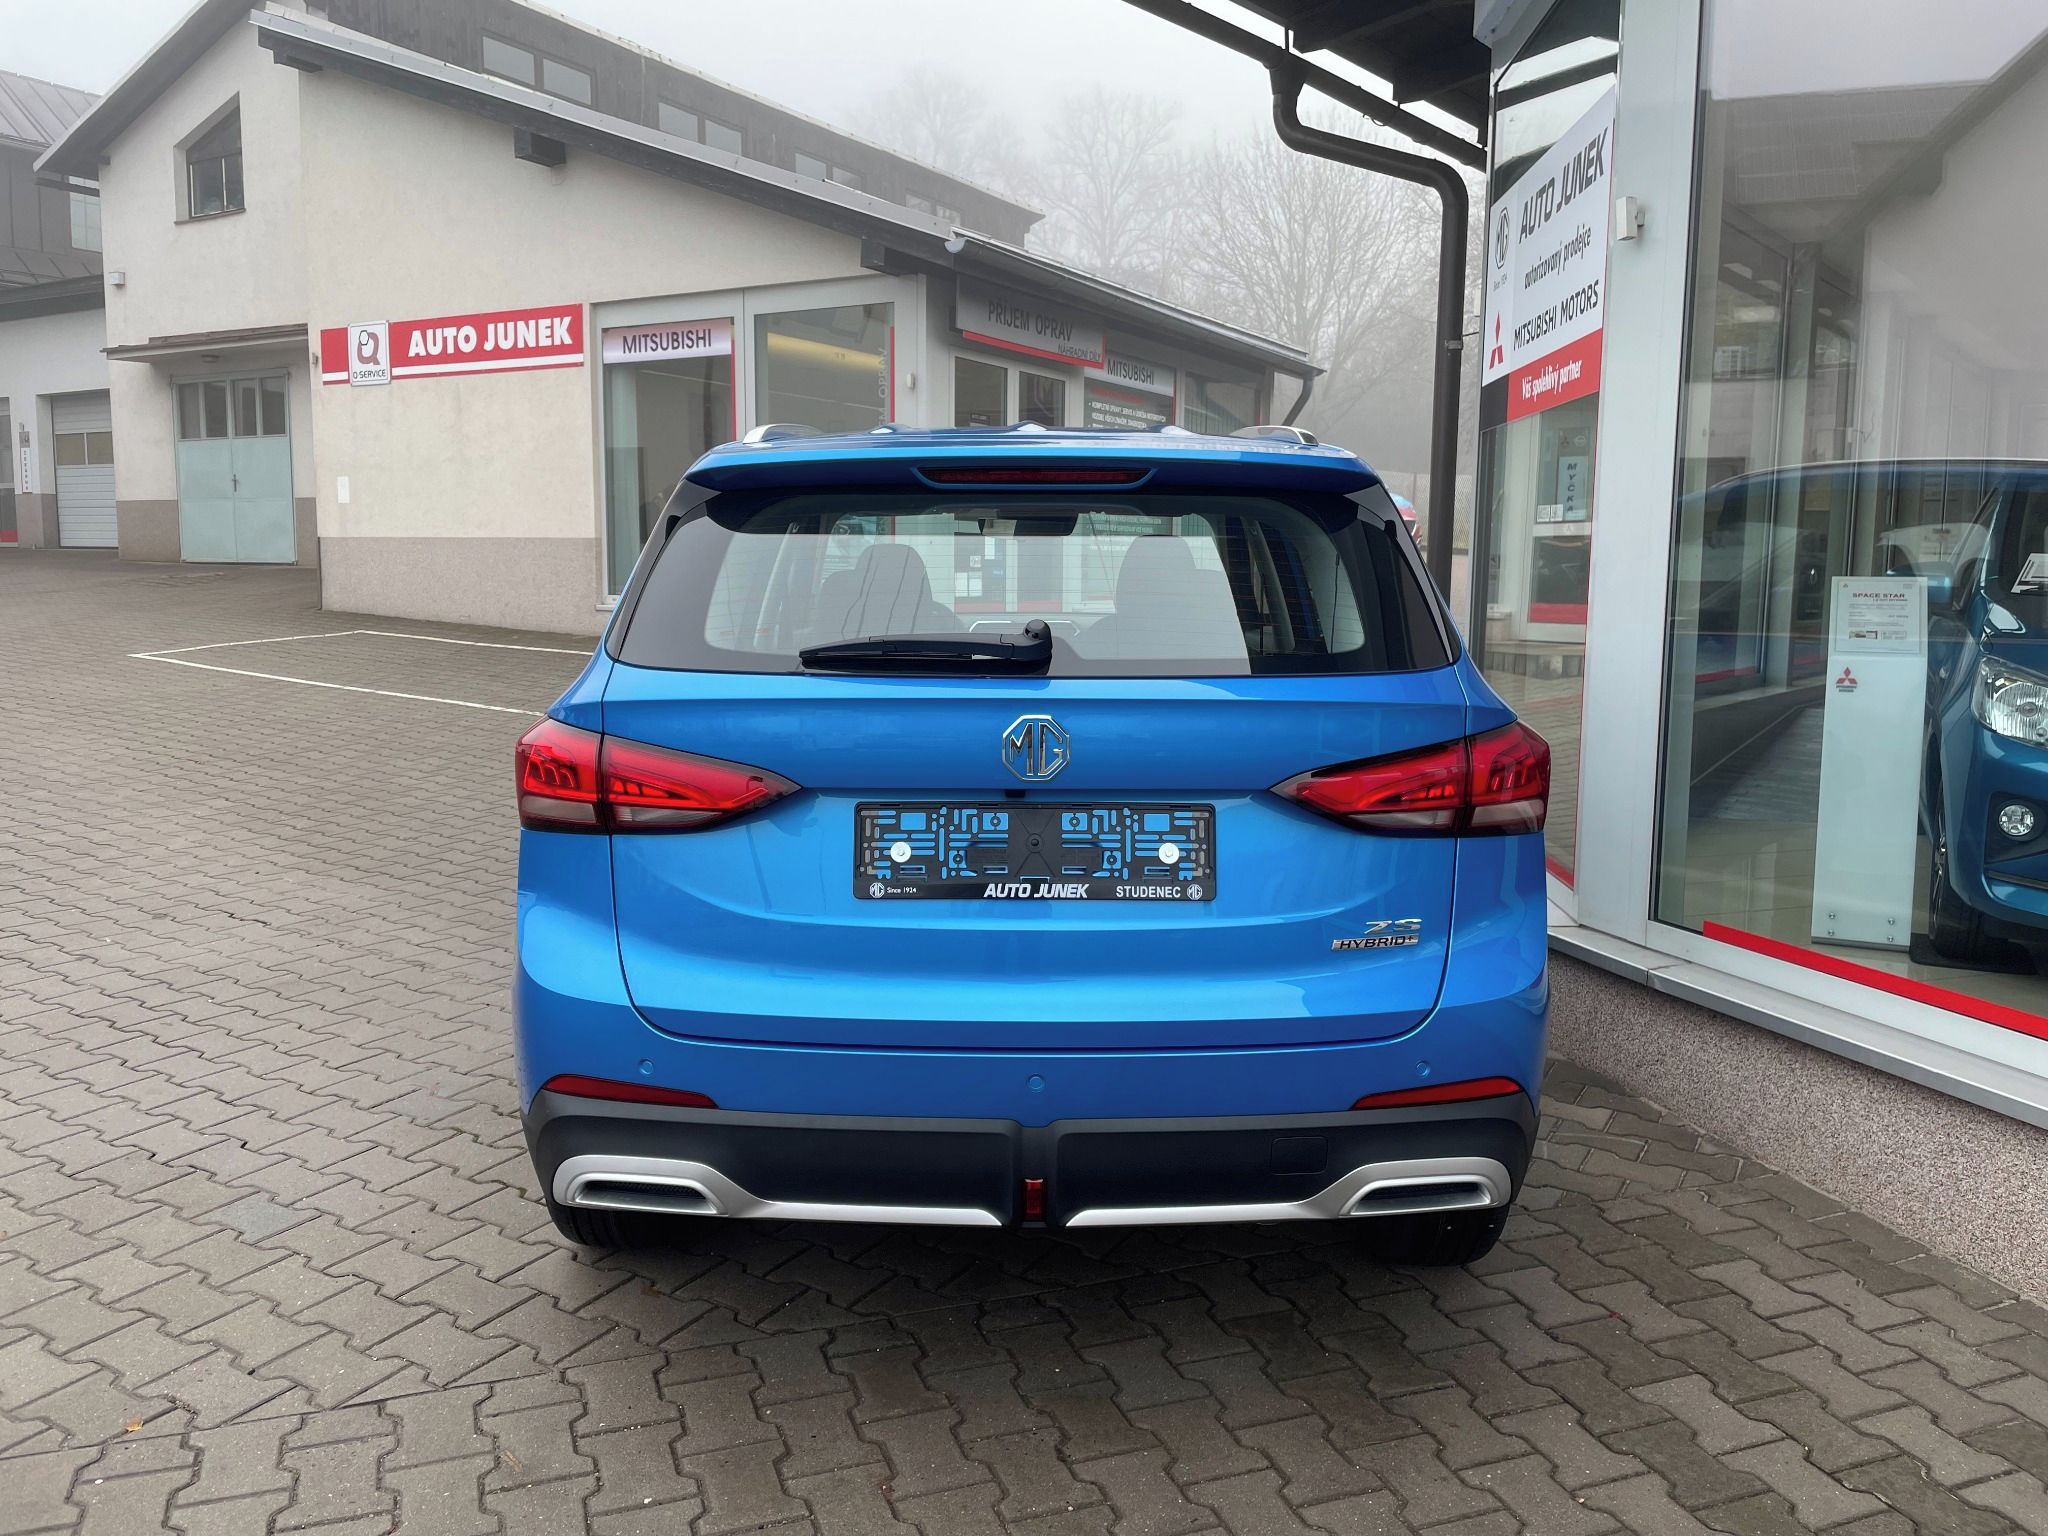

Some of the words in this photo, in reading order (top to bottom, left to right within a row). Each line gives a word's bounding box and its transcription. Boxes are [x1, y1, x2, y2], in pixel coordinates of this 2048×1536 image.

[1519, 176, 1555, 244] AUTO
[1556, 126, 1608, 214] JUNEK
[1563, 223, 1592, 272] prodejce
[1035, 315, 1073, 341] OPRAV
[1513, 305, 1557, 351] MITSUBISHI
[1560, 280, 1599, 326] MOTORS
[408, 325, 477, 357] AUTO
[483, 316, 573, 351] JUNEK
[622, 328, 712, 354] MITSUBISHI
[1107, 359, 1154, 385] MITSUBISHI
[1559, 360, 1582, 392] partner
[1006, 718, 1066, 778] MG
[870, 882, 885, 898] MG
[984, 883, 1031, 898] AUTO
[1033, 883, 1090, 898] JUNEK
[1116, 886, 1181, 898] STUDENEC
[1187, 883, 1203, 900] MG
[1364, 918, 1422, 934] ZS
